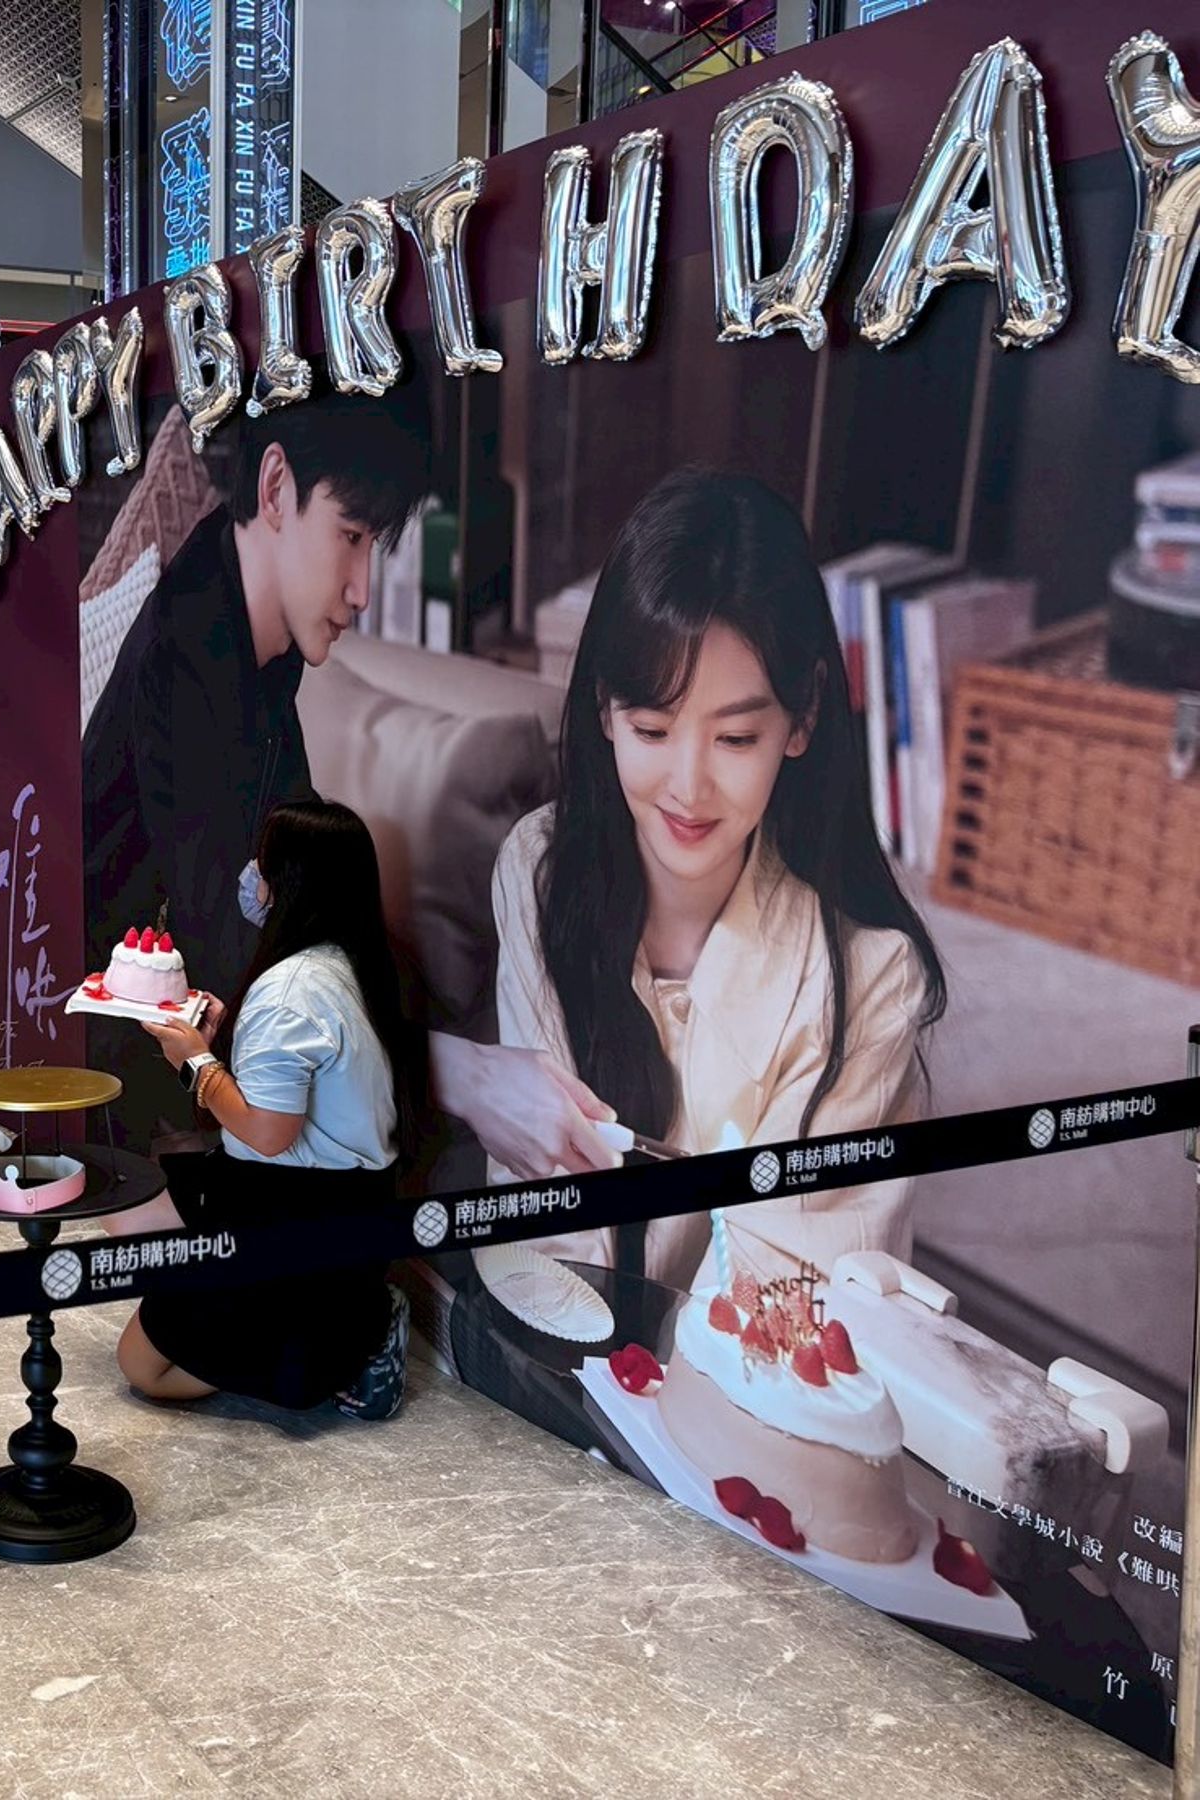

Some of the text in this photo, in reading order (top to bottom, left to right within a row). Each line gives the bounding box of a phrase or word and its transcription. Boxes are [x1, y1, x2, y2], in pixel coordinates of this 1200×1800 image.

[235, 43, 254, 69] FU
[235, 83, 255, 107] FA
[235, 119, 254, 156] XIN
[235, 168, 254, 194] FU
[235, 207, 254, 232] FA
[1060, 1094, 1156, 1131] 南紡購物中心
[786, 1135, 895, 1174] 南紡購物中心
[454, 1184, 581, 1226] 南紡購物中心
[455, 1224, 492, 1239] T.S. Mall
[89, 1231, 236, 1276] 南紡購物中心
[90, 1275, 133, 1290] T.S. Mall
[1133, 1514, 1183, 1555] 改編
[1151, 1651, 1175, 1680] 原
